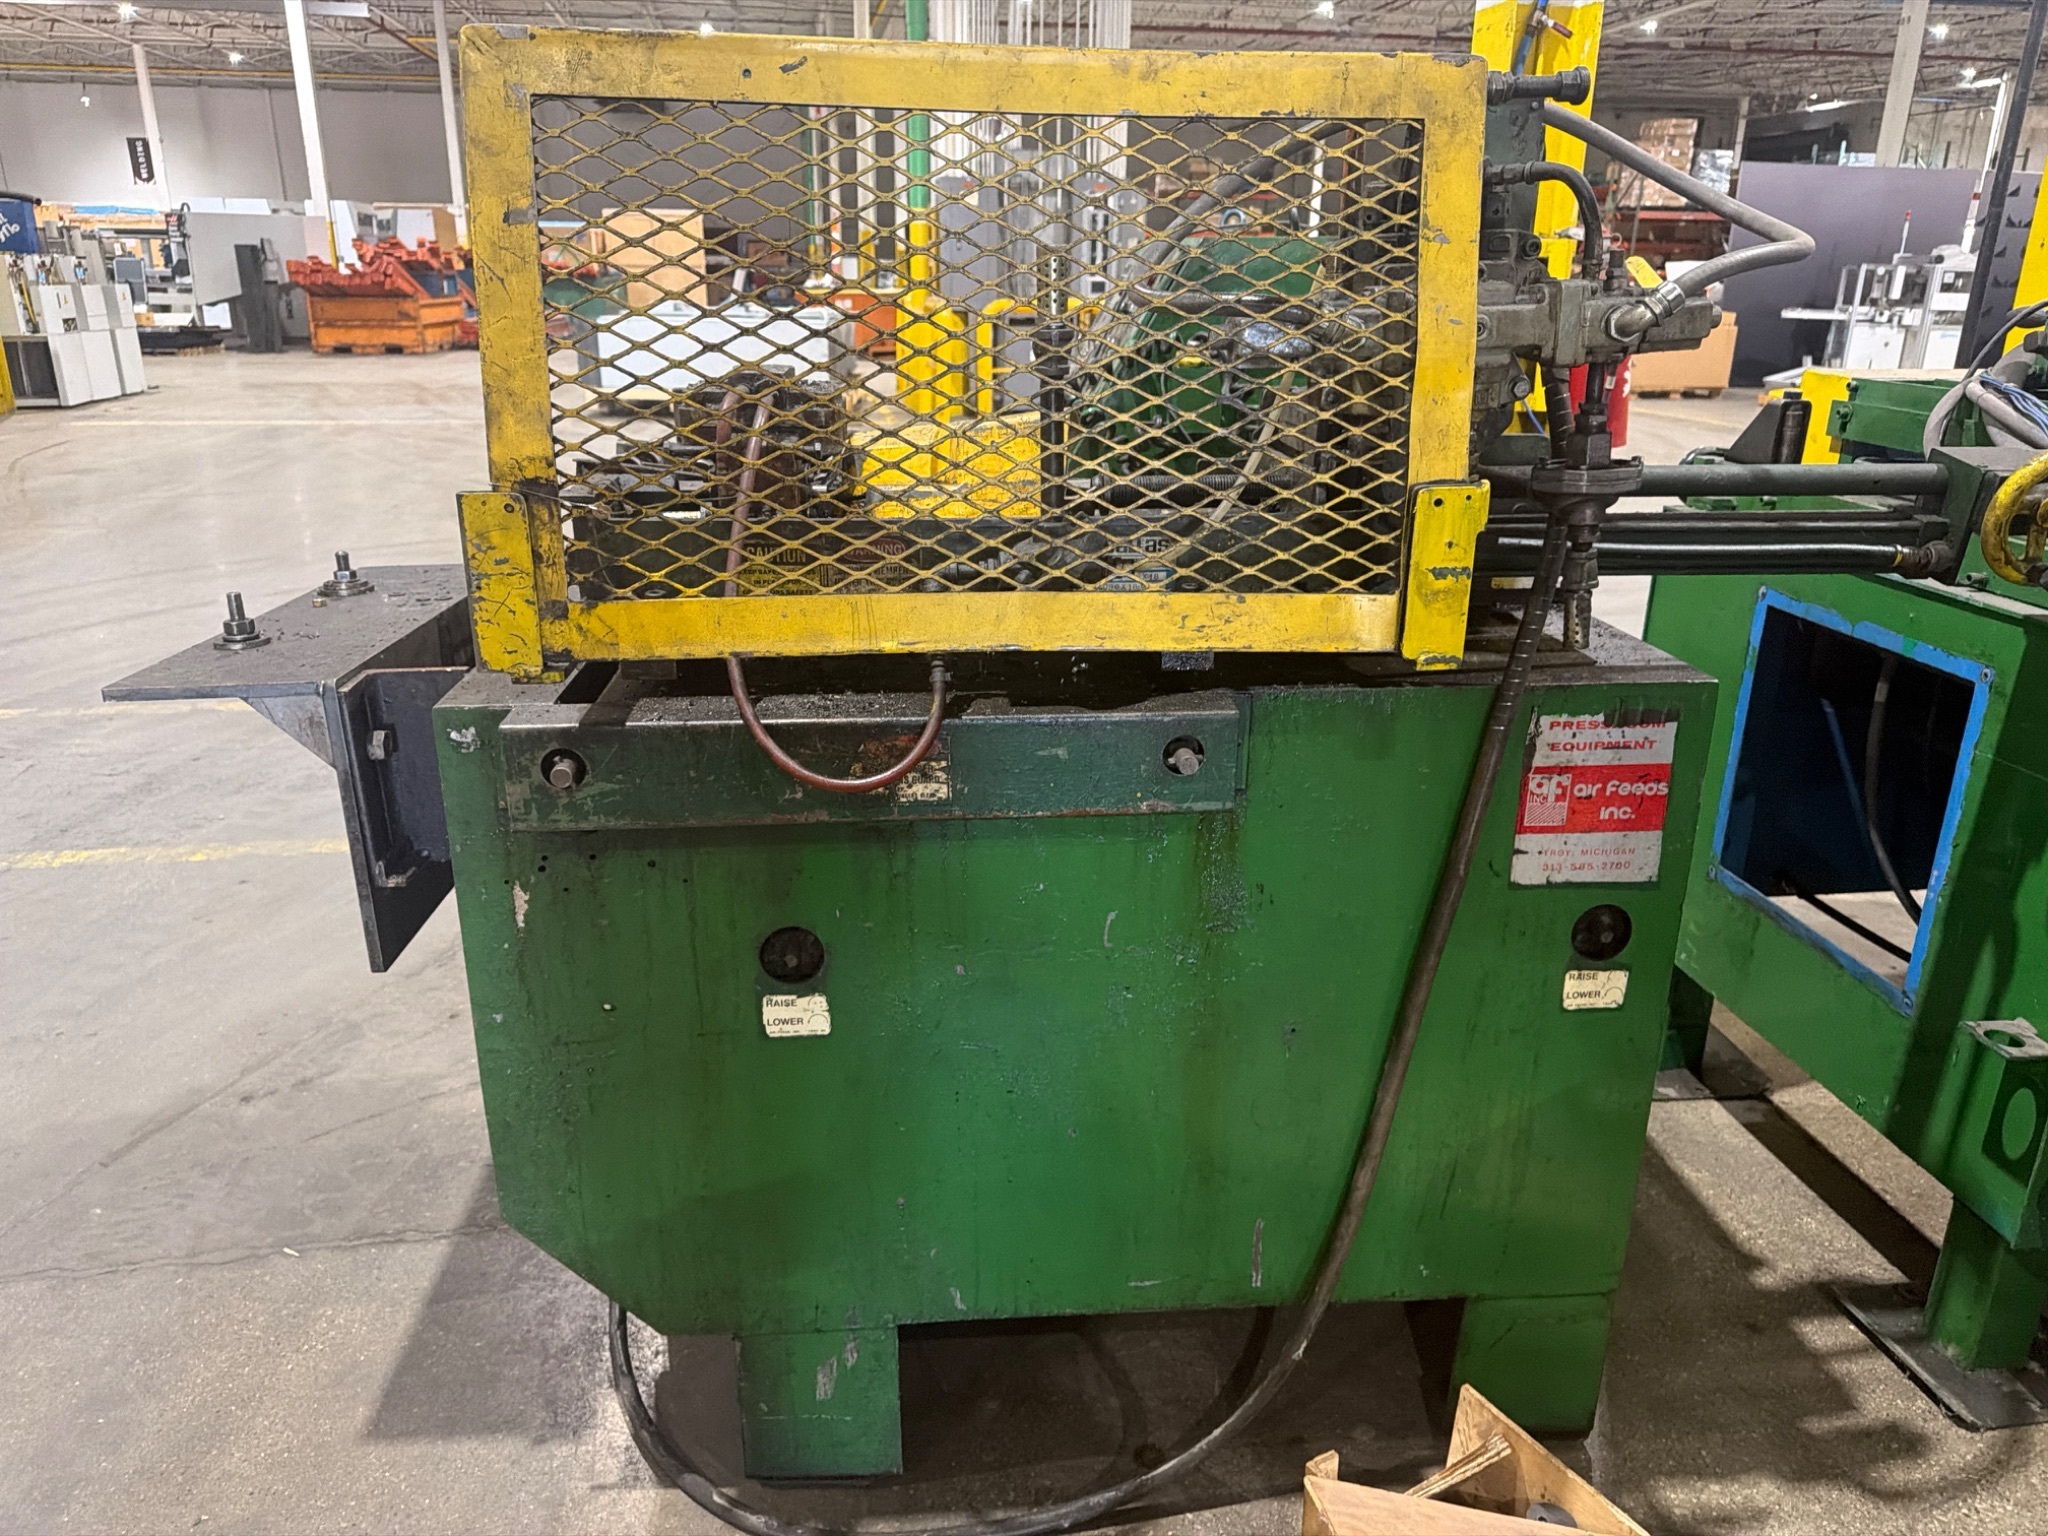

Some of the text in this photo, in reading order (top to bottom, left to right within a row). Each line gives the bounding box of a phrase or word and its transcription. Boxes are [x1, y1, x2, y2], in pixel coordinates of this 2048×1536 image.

[135, 140, 149, 179] WELDING
[1549, 740, 1657, 752] EQUIPMENT
[1573, 783, 1603, 797] air
[1600, 806, 1636, 819] inc.
[1580, 847, 1636, 856] MICHIGAN
[1568, 972, 1599, 981] RAISE
[1566, 990, 1601, 999] LOWER
[766, 999, 798, 1008] RAISE
[767, 1017, 804, 1026] LOWER
